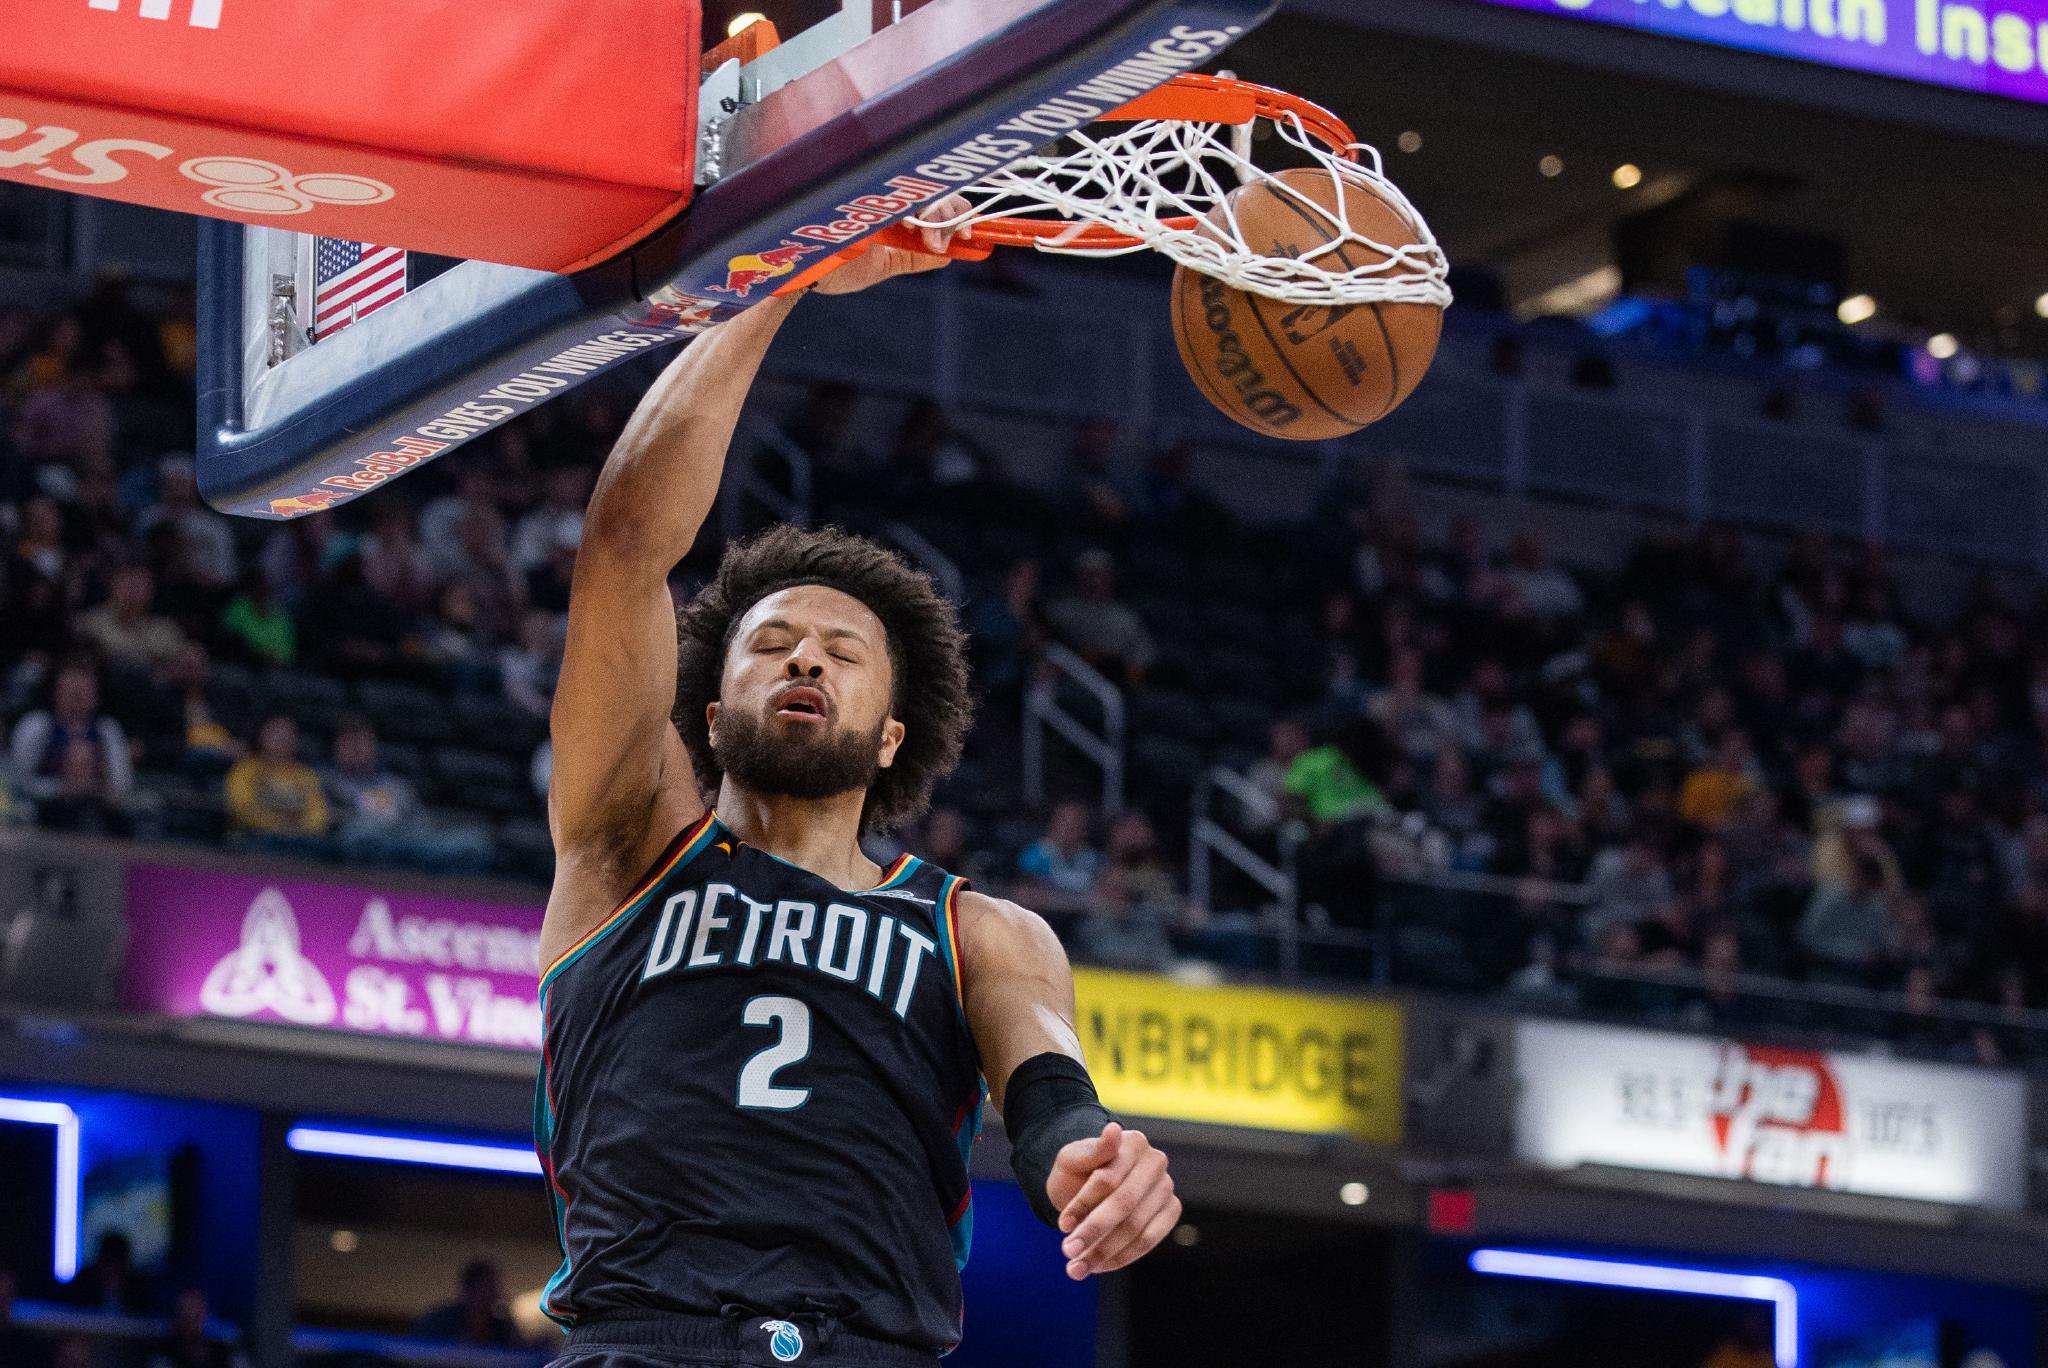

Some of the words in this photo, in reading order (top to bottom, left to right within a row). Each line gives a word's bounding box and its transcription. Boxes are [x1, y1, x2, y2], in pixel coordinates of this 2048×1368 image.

[1914, 0, 2048, 77] Ins
[915, 133, 1032, 182] GIVES
[997, 98, 1102, 137] YOU
[416, 401, 514, 440] GIVES
[478, 373, 568, 403] YOU
[348, 897, 540, 973] Ascen
[640, 882, 937, 1021] DETROIT
[736, 994, 812, 1111] 2
[1088, 1008, 1374, 1108] NBRIDGE
